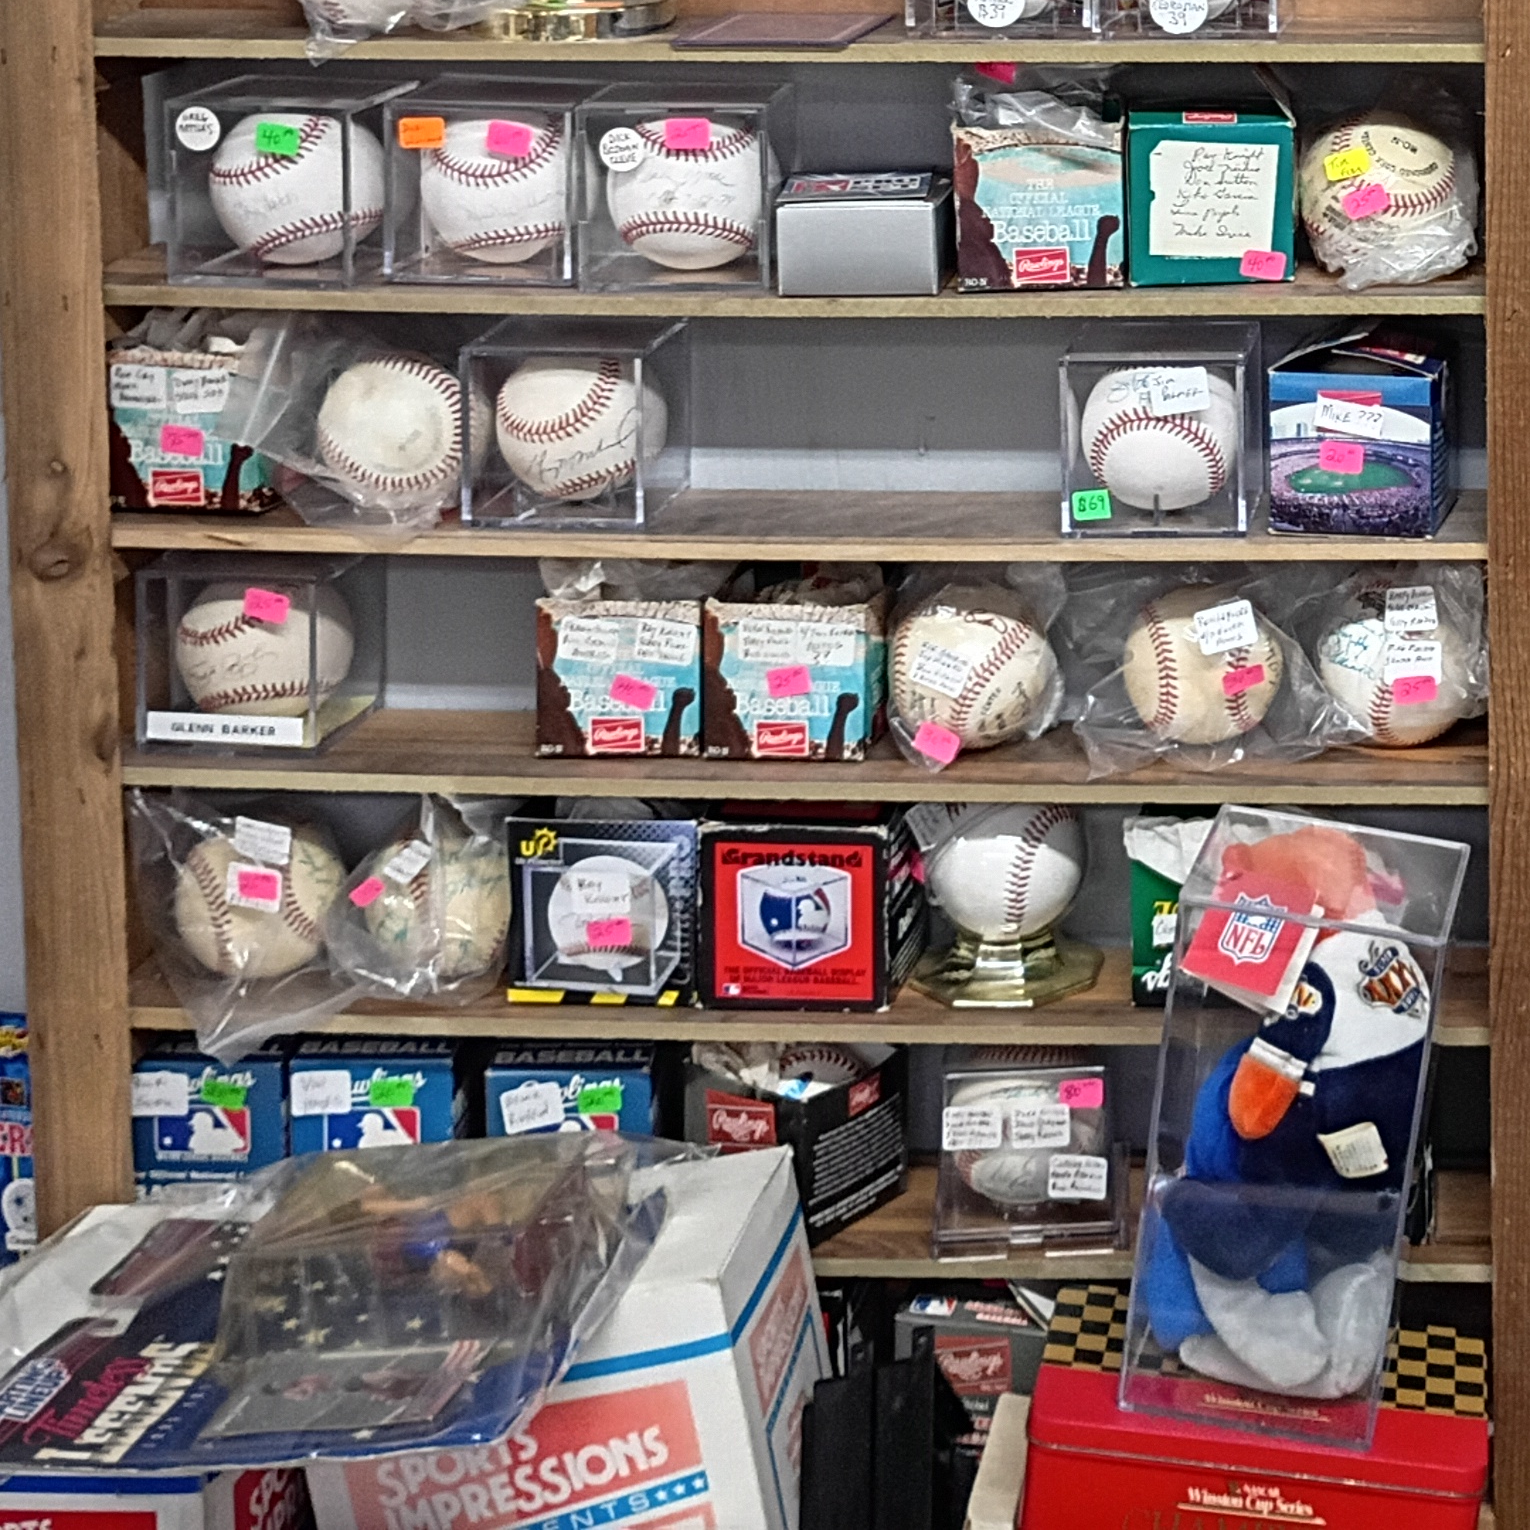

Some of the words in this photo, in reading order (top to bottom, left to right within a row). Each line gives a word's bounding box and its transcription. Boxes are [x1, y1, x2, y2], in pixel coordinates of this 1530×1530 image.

[1026, 178, 1054, 192] THE
[1009, 192, 1069, 205] OFFICIAL
[991, 219, 1093, 244] Baseball
[1018, 256, 1065, 275] Rawlings
[170, 723, 214, 734] GLENN
[221, 724, 276, 737] BARKER
[722, 848, 864, 868] Grandstand
[1225, 926, 1267, 957] NFL
[376, 1423, 538, 1500] SPORTS
[383, 1426, 671, 1530] IMPRESSIONS
[1187, 1485, 1245, 1511] Winston
[1245, 1493, 1274, 1516] Cup
